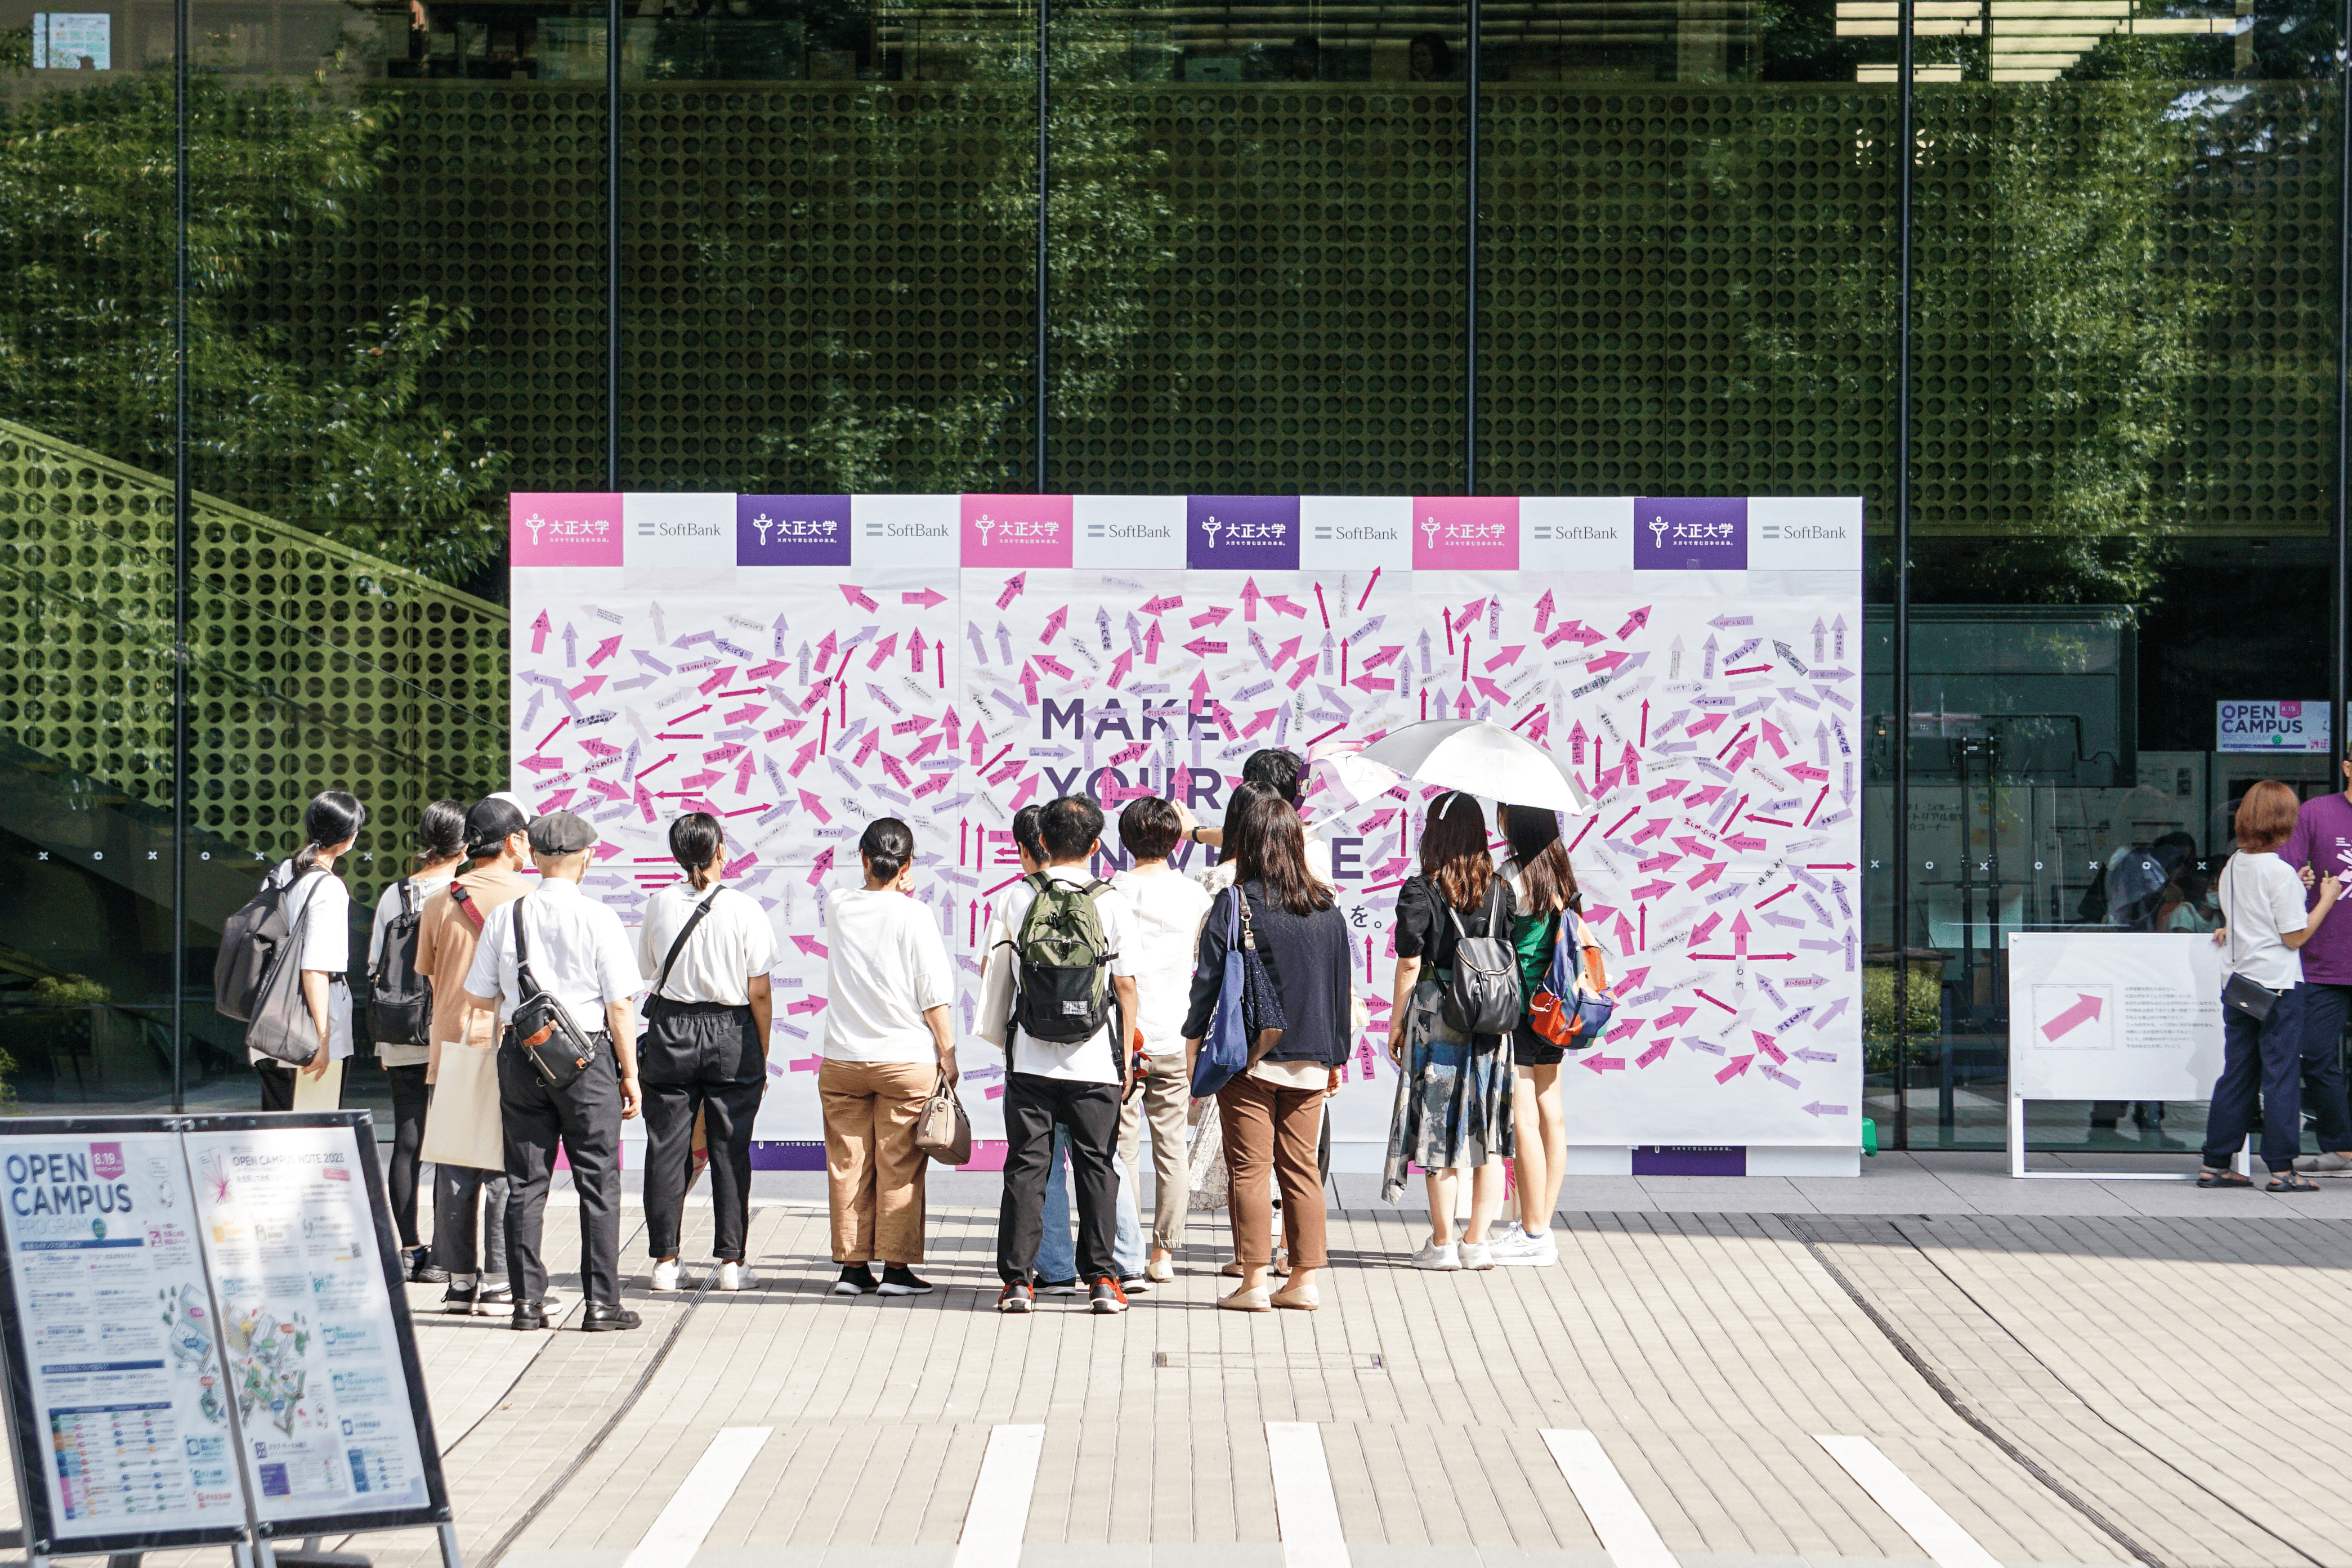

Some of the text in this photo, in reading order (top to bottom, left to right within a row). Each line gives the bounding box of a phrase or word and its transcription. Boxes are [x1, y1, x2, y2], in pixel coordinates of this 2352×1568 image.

[549, 520, 609, 535] 大正大学
[660, 523, 721, 536] SoftBank
[777, 521, 837, 535] 大正大学
[887, 523, 949, 537] SoftBank
[999, 521, 1059, 536] 大正大学
[1109, 525, 1171, 538] SoftBank
[1226, 523, 1286, 539] 大正大学
[1336, 526, 1398, 540] SoftBank
[1445, 524, 1505, 539] 大正大学
[1555, 526, 1617, 539] SoftBank
[1673, 523, 1733, 538] 大正大学
[1784, 526, 1846, 539] SoftBank
[1043, 698, 1219, 740] MAKE
[2221, 705, 2275, 719] OPEN
[2221, 720, 2302, 733] CAMPUS
[1043, 767, 1222, 809] YOUR
[93, 1153, 116, 1165] 8.19
[233, 1153, 345, 1166] OPEN CAMPUS NOTE 2023
[7, 1153, 88, 1184] OPEN
[11, 1184, 133, 1216] CAMPUS
